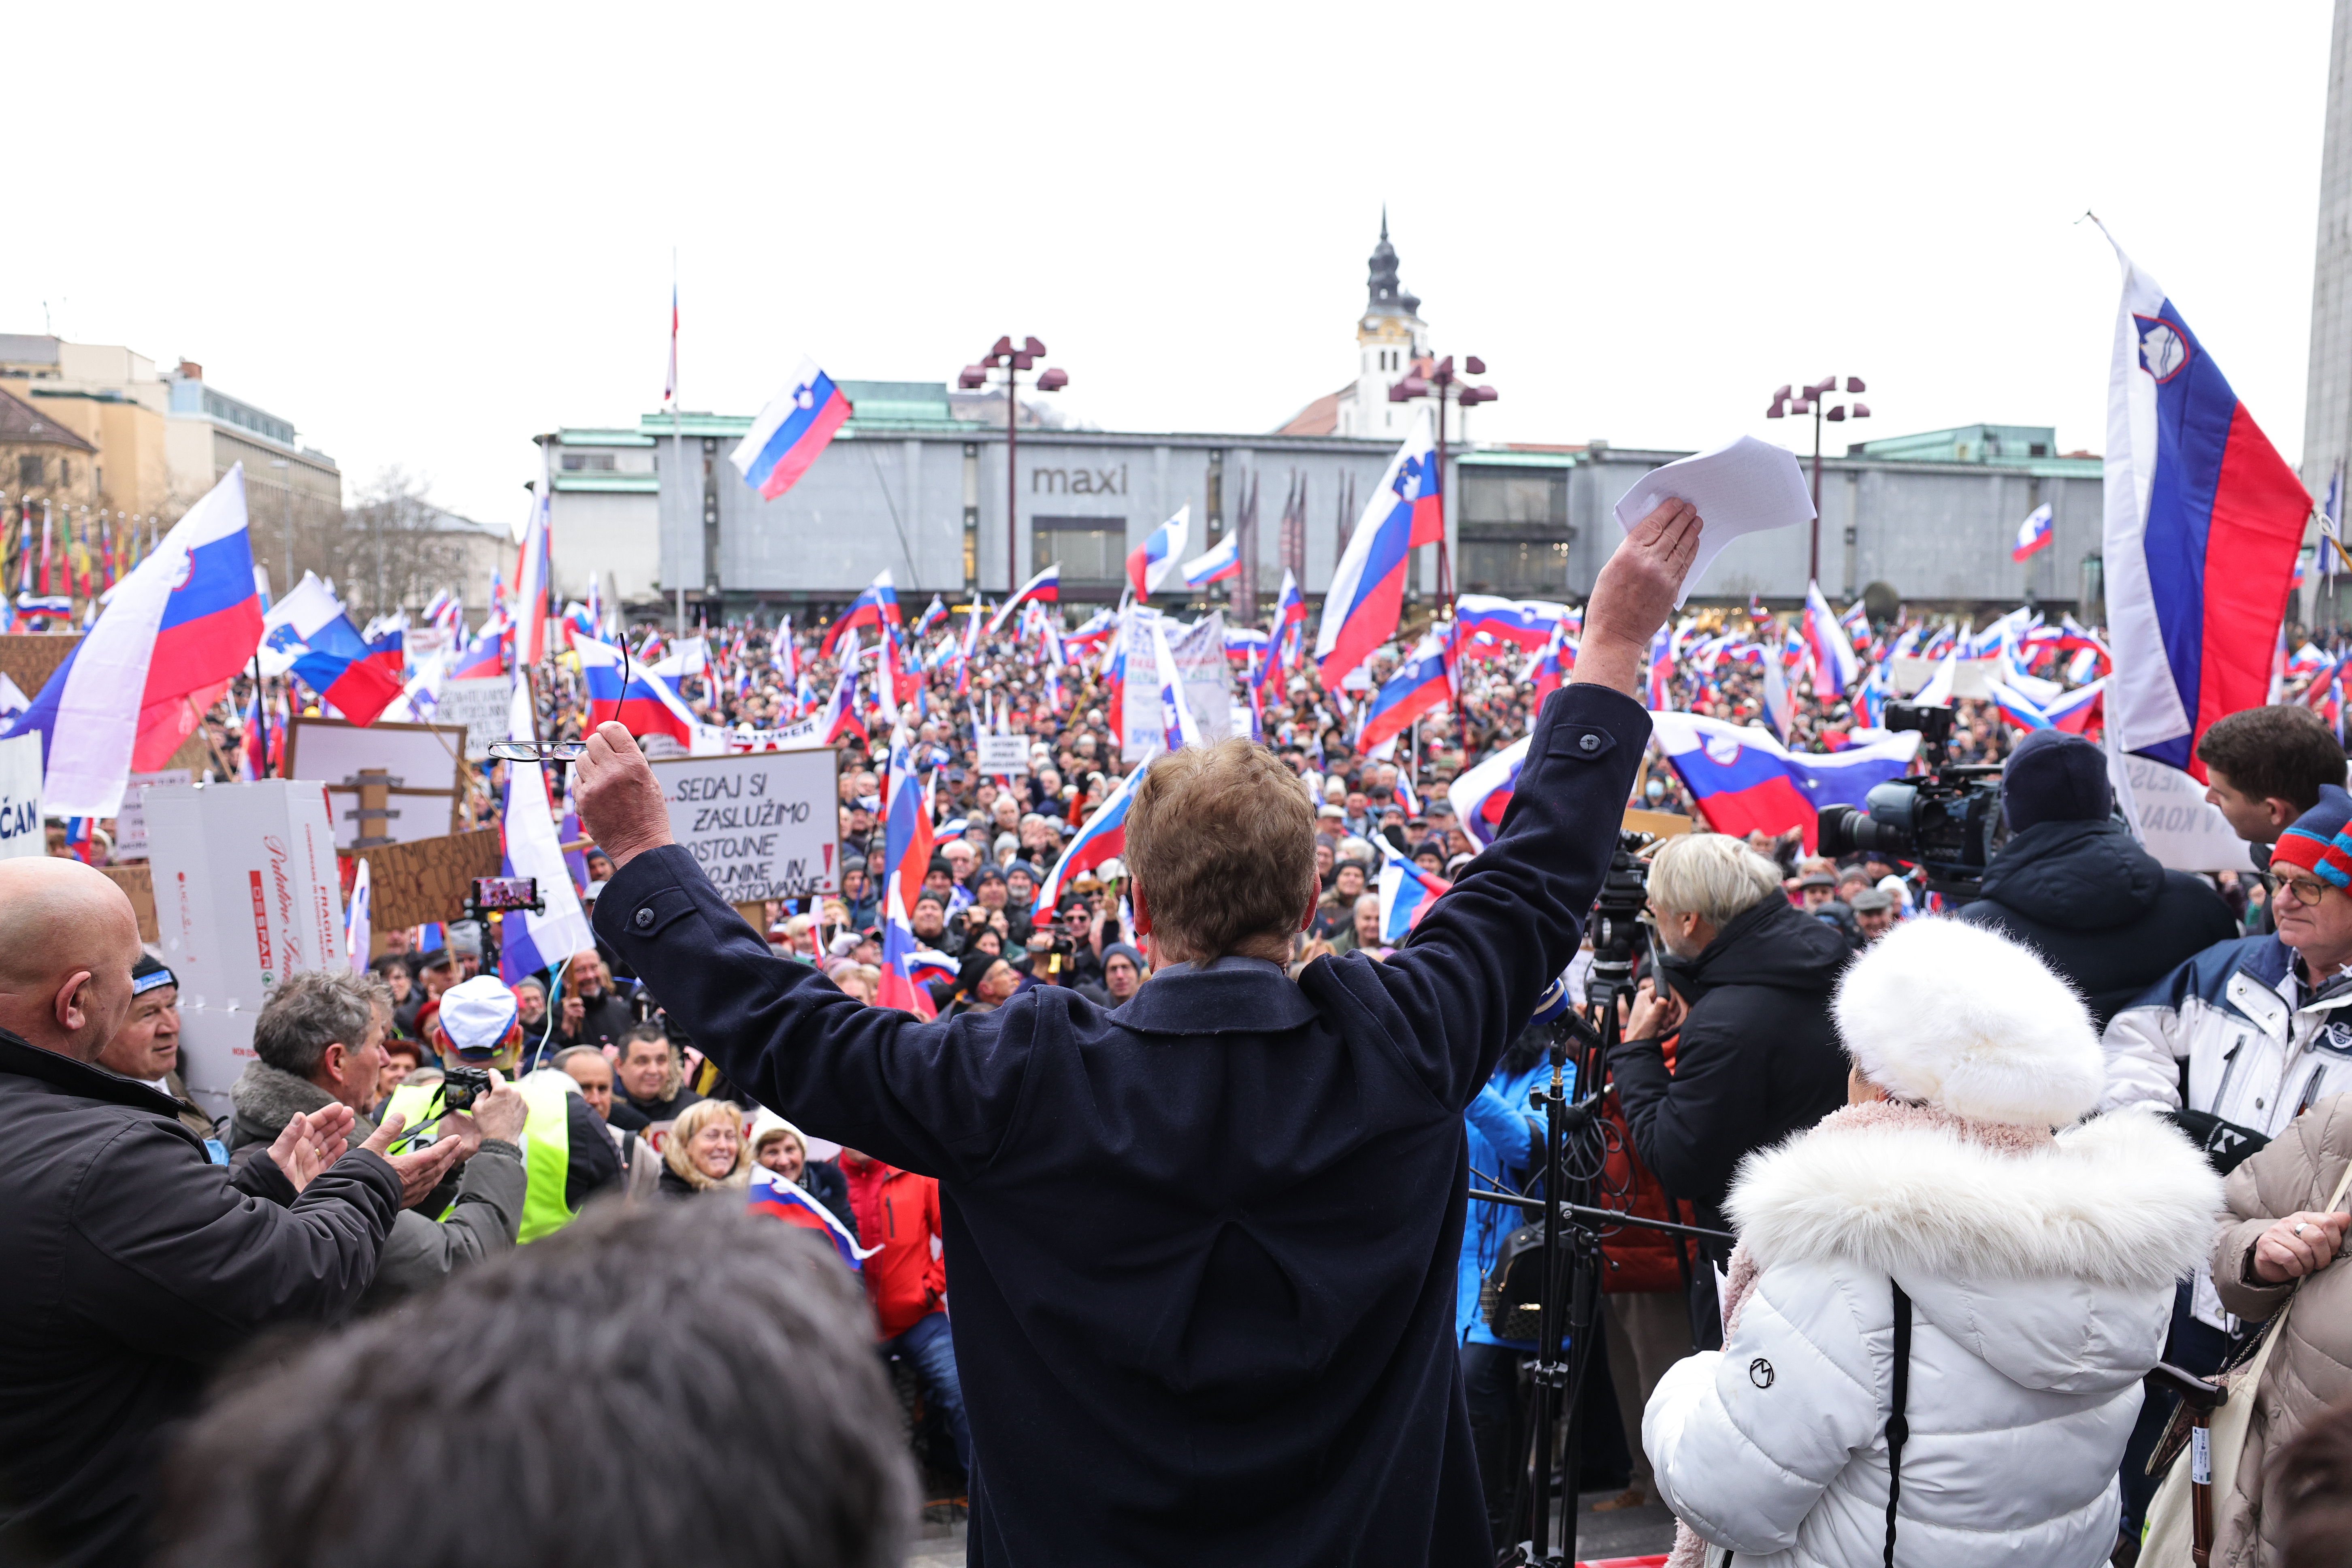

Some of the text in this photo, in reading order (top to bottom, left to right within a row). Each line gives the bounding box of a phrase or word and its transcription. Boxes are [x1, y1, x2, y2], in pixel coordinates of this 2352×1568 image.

[1032, 465, 1127, 494] maxi
[748, 772, 768, 798] SI
[692, 799, 810, 832] ZASLUŽIMO
[675, 833, 779, 862] OSTOJNE
[786, 858, 807, 879] IN
[717, 875, 824, 903] OŠTOVANJE
[251, 885, 272, 968] DESPAR
[320, 886, 335, 959] FRAGILE
